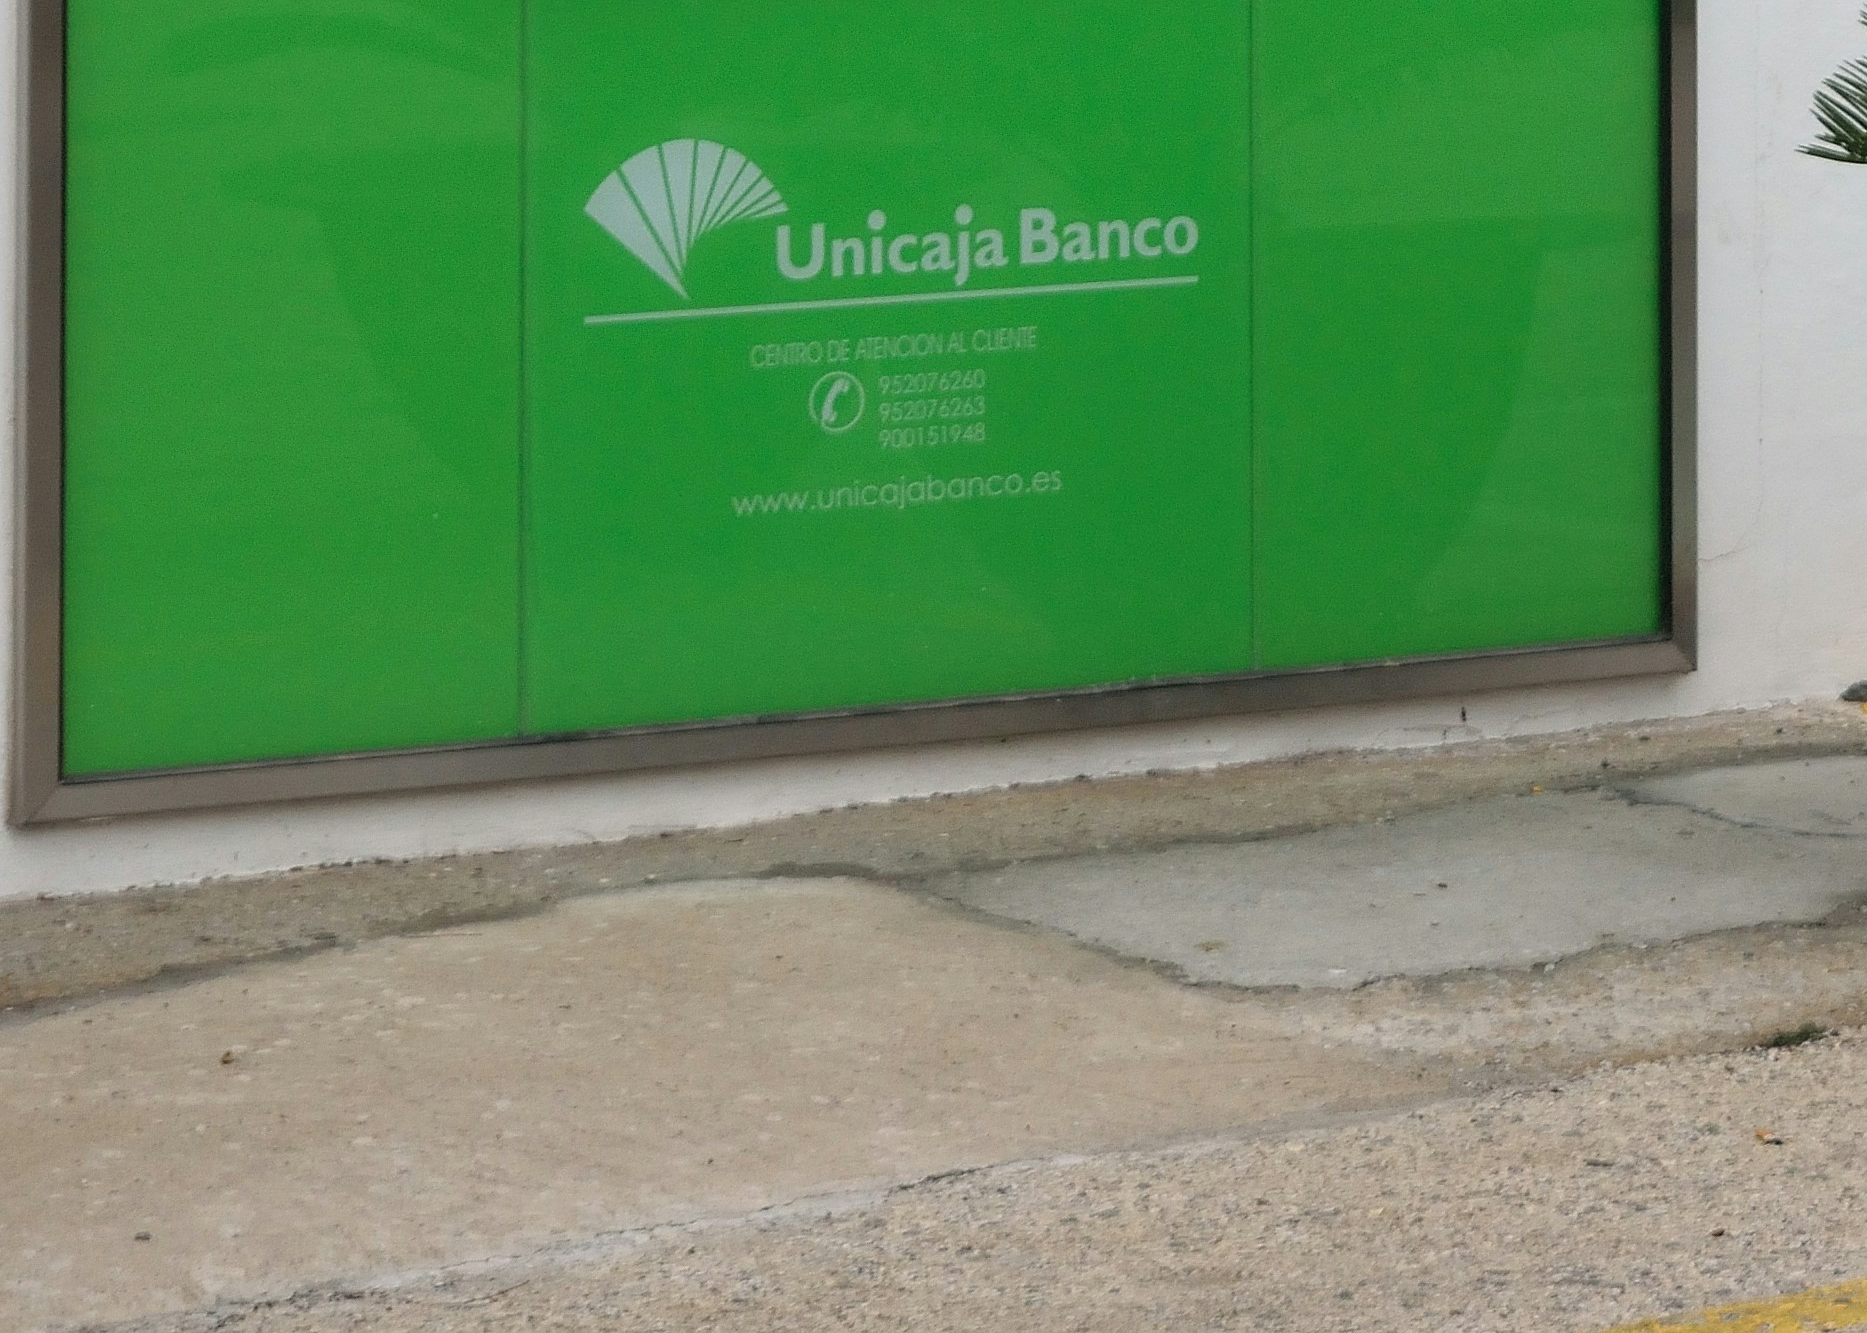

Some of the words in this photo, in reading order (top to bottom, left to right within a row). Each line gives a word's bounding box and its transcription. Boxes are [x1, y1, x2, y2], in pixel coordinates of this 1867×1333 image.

[776, 204, 1008, 286] Unicaja
[1019, 207, 1199, 266] Banco
[751, 342, 822, 369] CENTRO
[826, 340, 849, 363] DE
[948, 332, 967, 353] AL
[971, 326, 1037, 353] CLIENTE
[879, 369, 986, 395] 952076260
[879, 396, 986, 422] 952076263
[879, 422, 986, 449] 900151948
[732, 470, 1062, 517] www.unicajabanco.es
